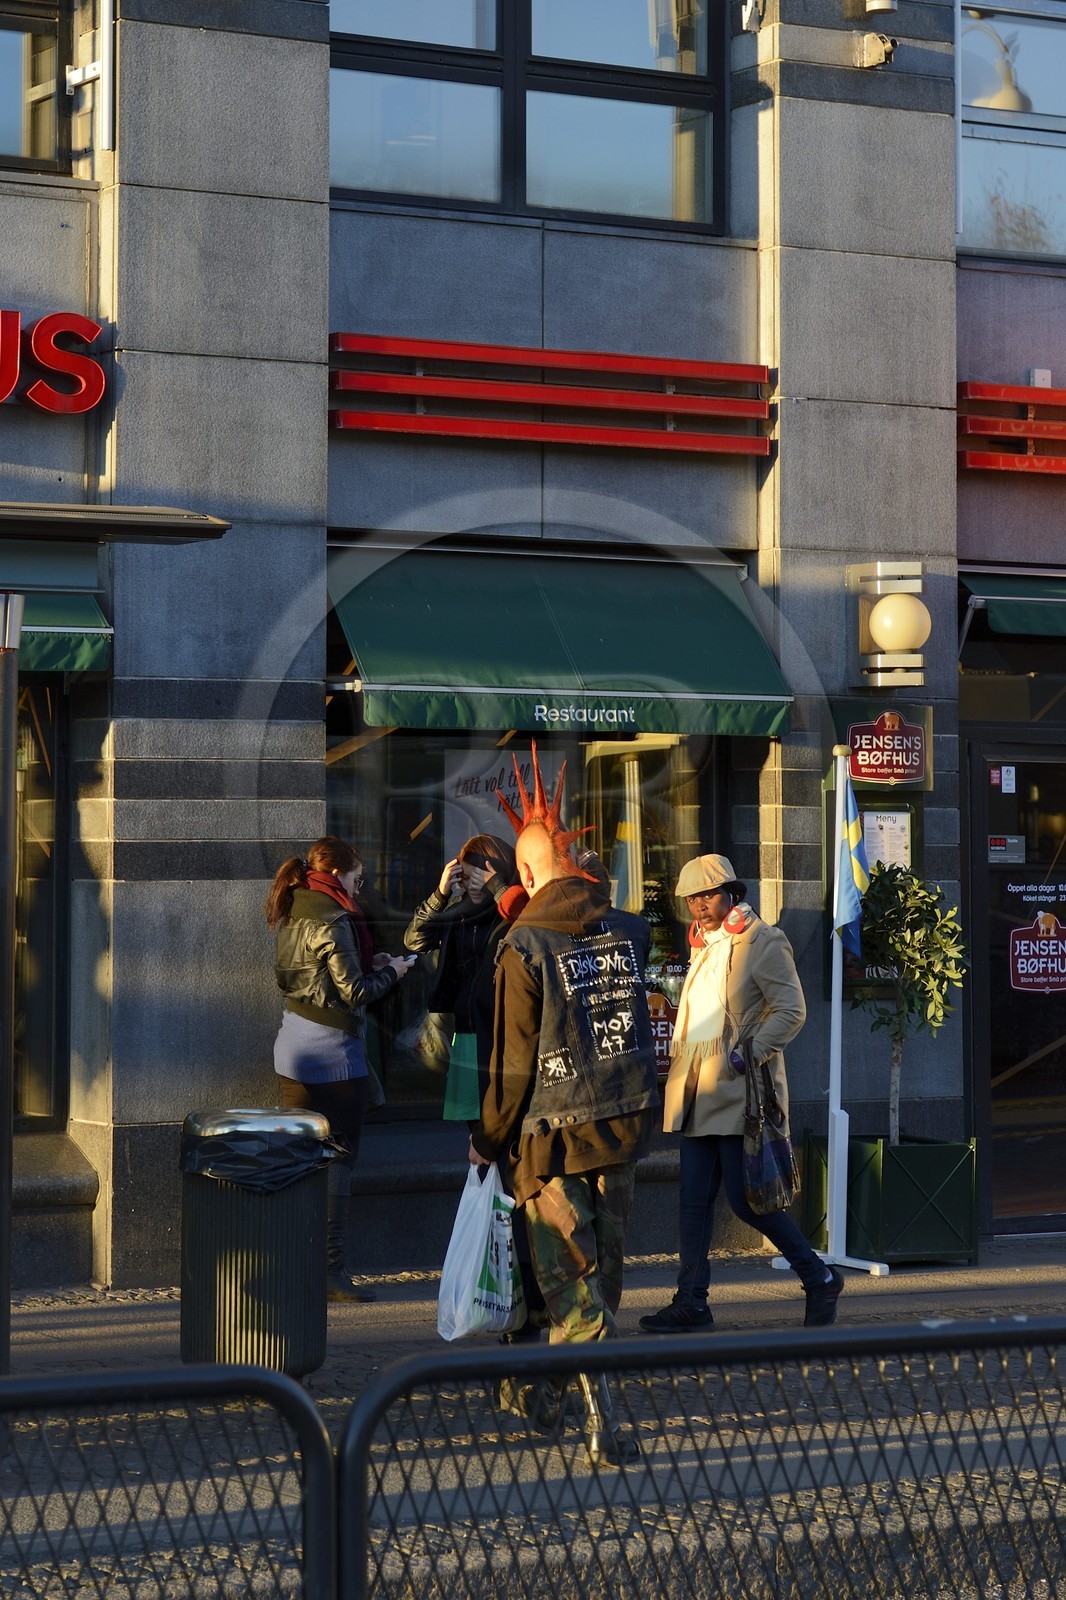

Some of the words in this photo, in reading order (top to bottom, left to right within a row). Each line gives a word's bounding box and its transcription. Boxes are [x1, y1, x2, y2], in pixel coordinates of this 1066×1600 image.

[534, 704, 635, 722] Restaurant
[854, 735, 921, 750] JENSEN'S
[857, 751, 920, 766] BØFHUS
[485, 767, 505, 793] val
[876, 815, 897, 824] Meny
[1007, 883, 1026, 893] Öppet
[1026, 884, 1038, 892] alla
[1038, 884, 1056, 893] dagar
[593, 1012, 633, 1036] MOB
[602, 1035, 625, 1053] 47
